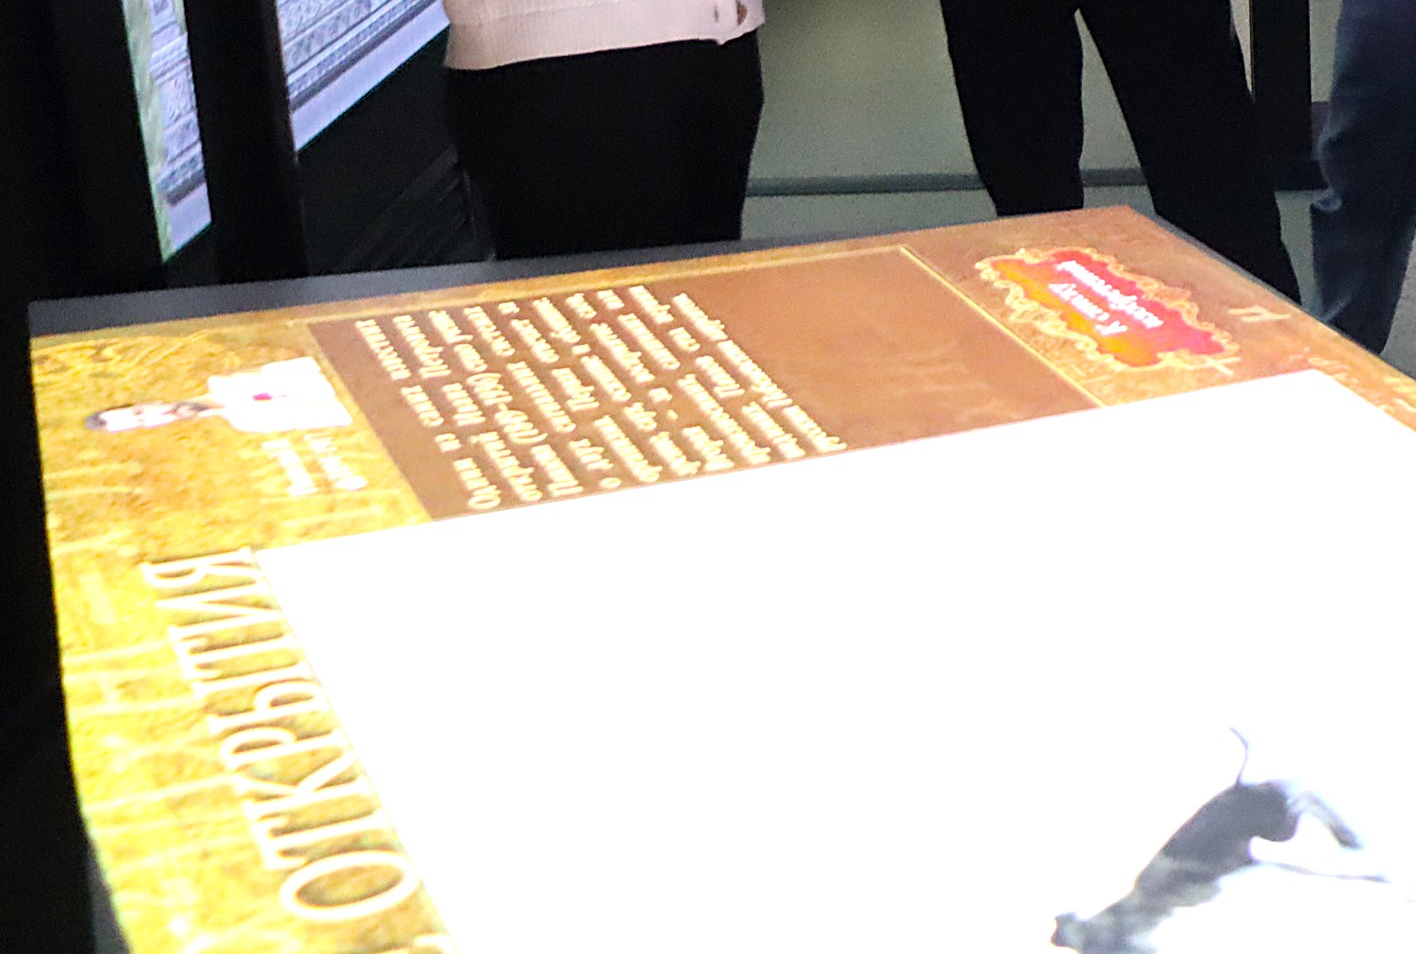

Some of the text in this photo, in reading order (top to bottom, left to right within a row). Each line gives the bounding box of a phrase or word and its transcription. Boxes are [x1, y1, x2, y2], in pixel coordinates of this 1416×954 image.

[596, 289, 624, 310] или
[571, 343, 591, 355] и
[1095, 320, 1128, 336] К
[439, 343, 487, 372] стало
[628, 285, 804, 459] видимых. Павлов стал первым
[717, 339, 792, 408] Нобелевским
[354, 319, 500, 510] Одним из самых известных
[392, 314, 553, 503] открытий Ивана Петровича
[463, 306, 621, 490] о двух сигнальных системах
[497, 301, 662, 483] организма. Первая отвечает за
[623, 401, 657, 431] слух,
[647, 387, 672, 403] за
[681, 426, 734, 472] Вторая
[782, 405, 846, 453] русским
[529, 444, 582, 497] Павлова
[141, 545, 421, 921] ОТКРЫТИЯ
